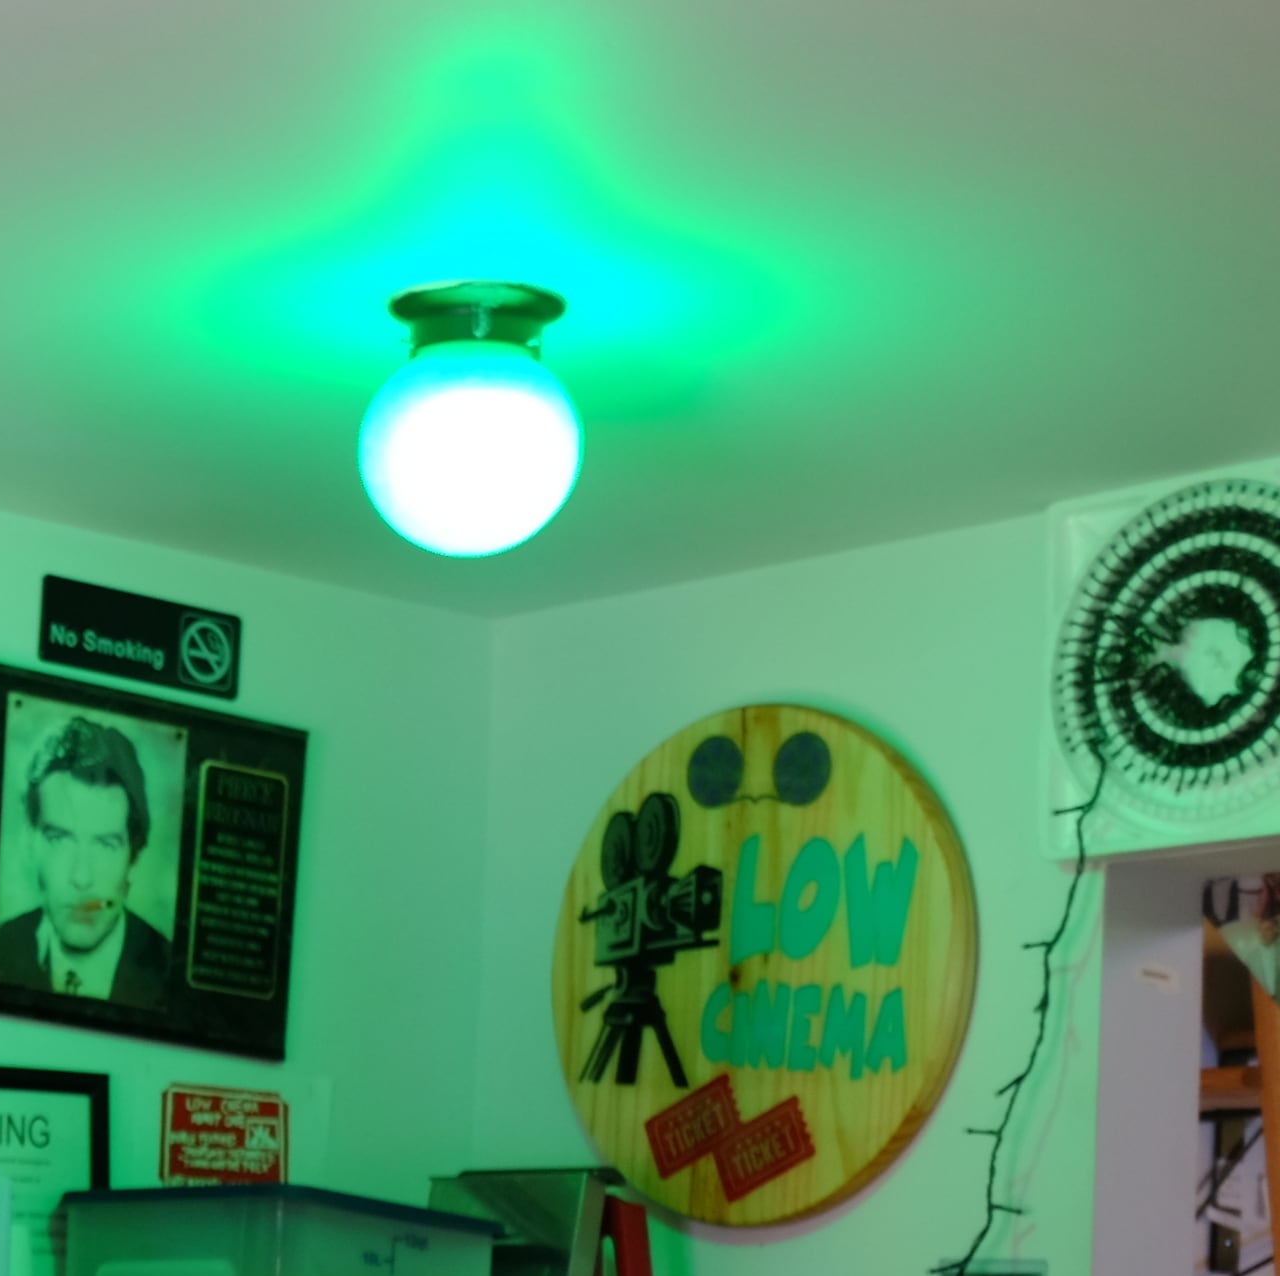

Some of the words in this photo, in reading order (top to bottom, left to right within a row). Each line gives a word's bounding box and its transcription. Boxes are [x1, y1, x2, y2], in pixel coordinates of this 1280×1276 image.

[50, 621, 78, 648] No
[82, 628, 165, 671] Smoking
[729, 831, 920, 969] LOW
[700, 978, 908, 1082] CINEMA
[665, 1102, 726, 1157] TICKET
[732, 1124, 796, 1180] TICKET
